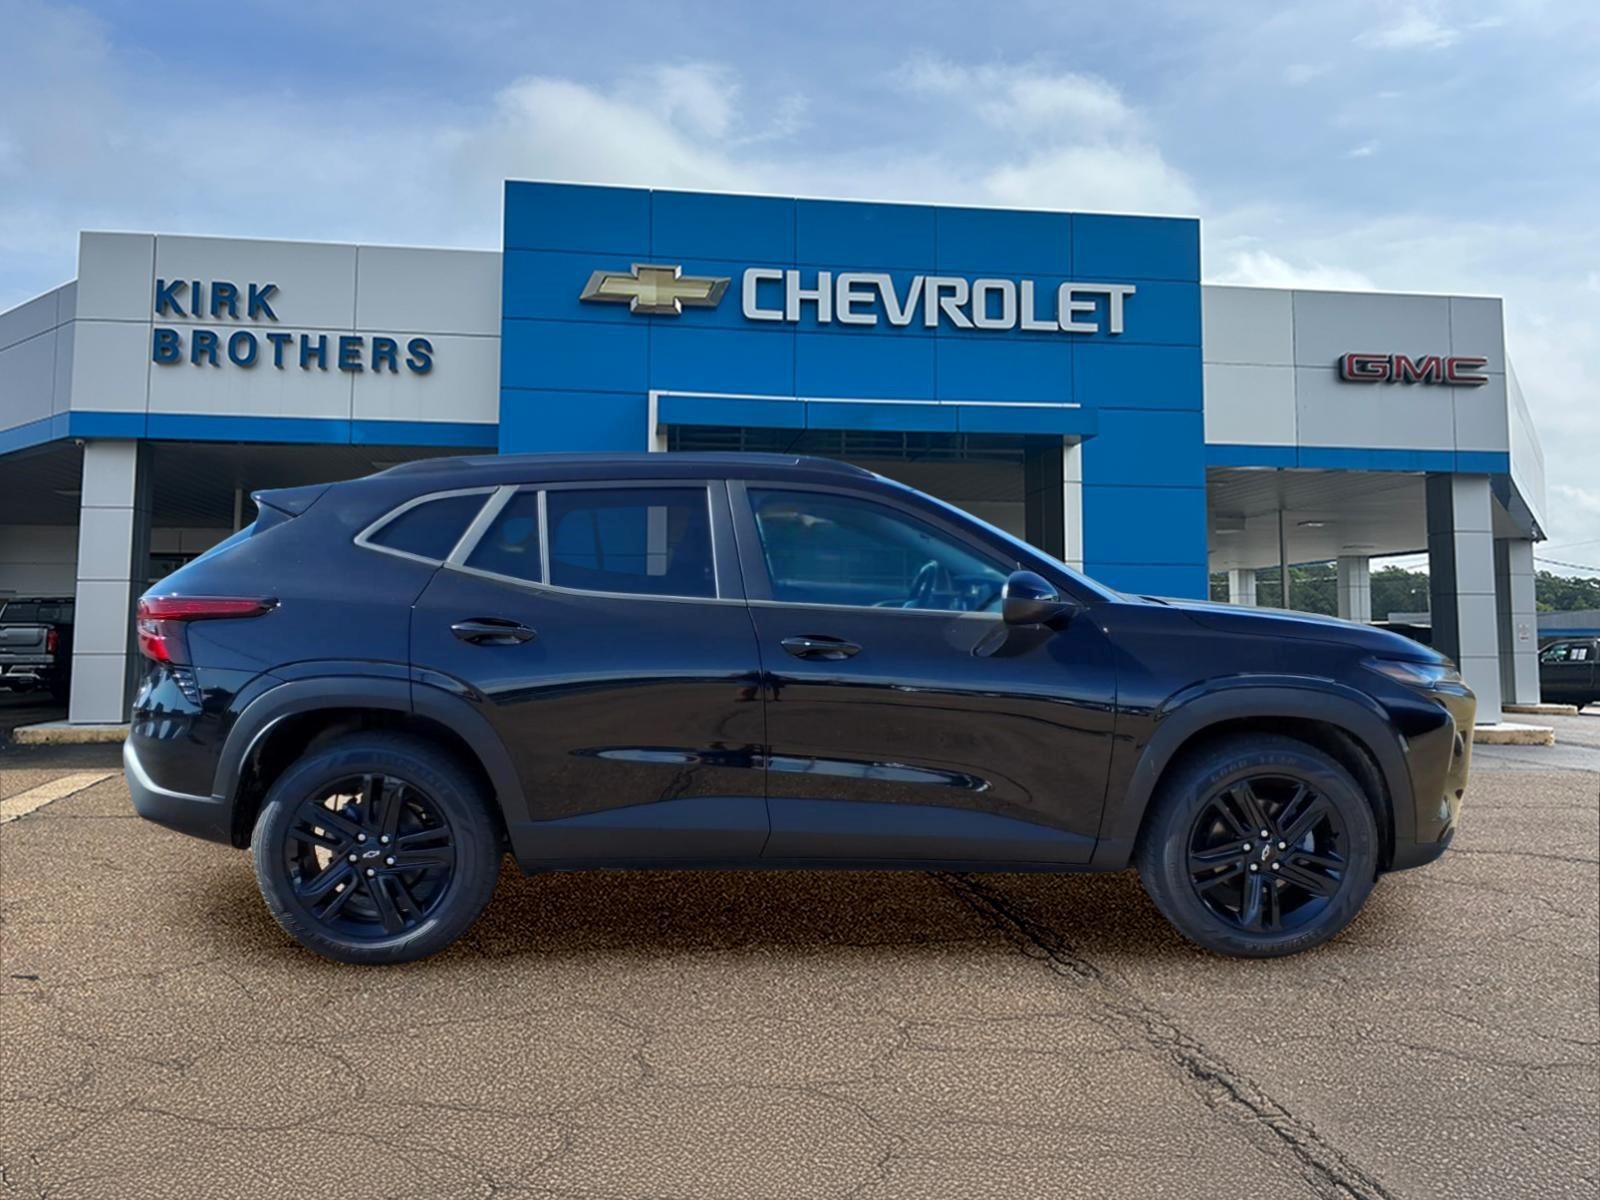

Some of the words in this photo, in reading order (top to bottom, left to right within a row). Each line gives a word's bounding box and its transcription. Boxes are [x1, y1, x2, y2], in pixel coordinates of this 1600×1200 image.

[155, 278, 279, 321] KIRK
[742, 267, 1136, 334] CHEVROLET
[152, 327, 434, 374] BROTHERS
[1340, 352, 1489, 386] GMC
